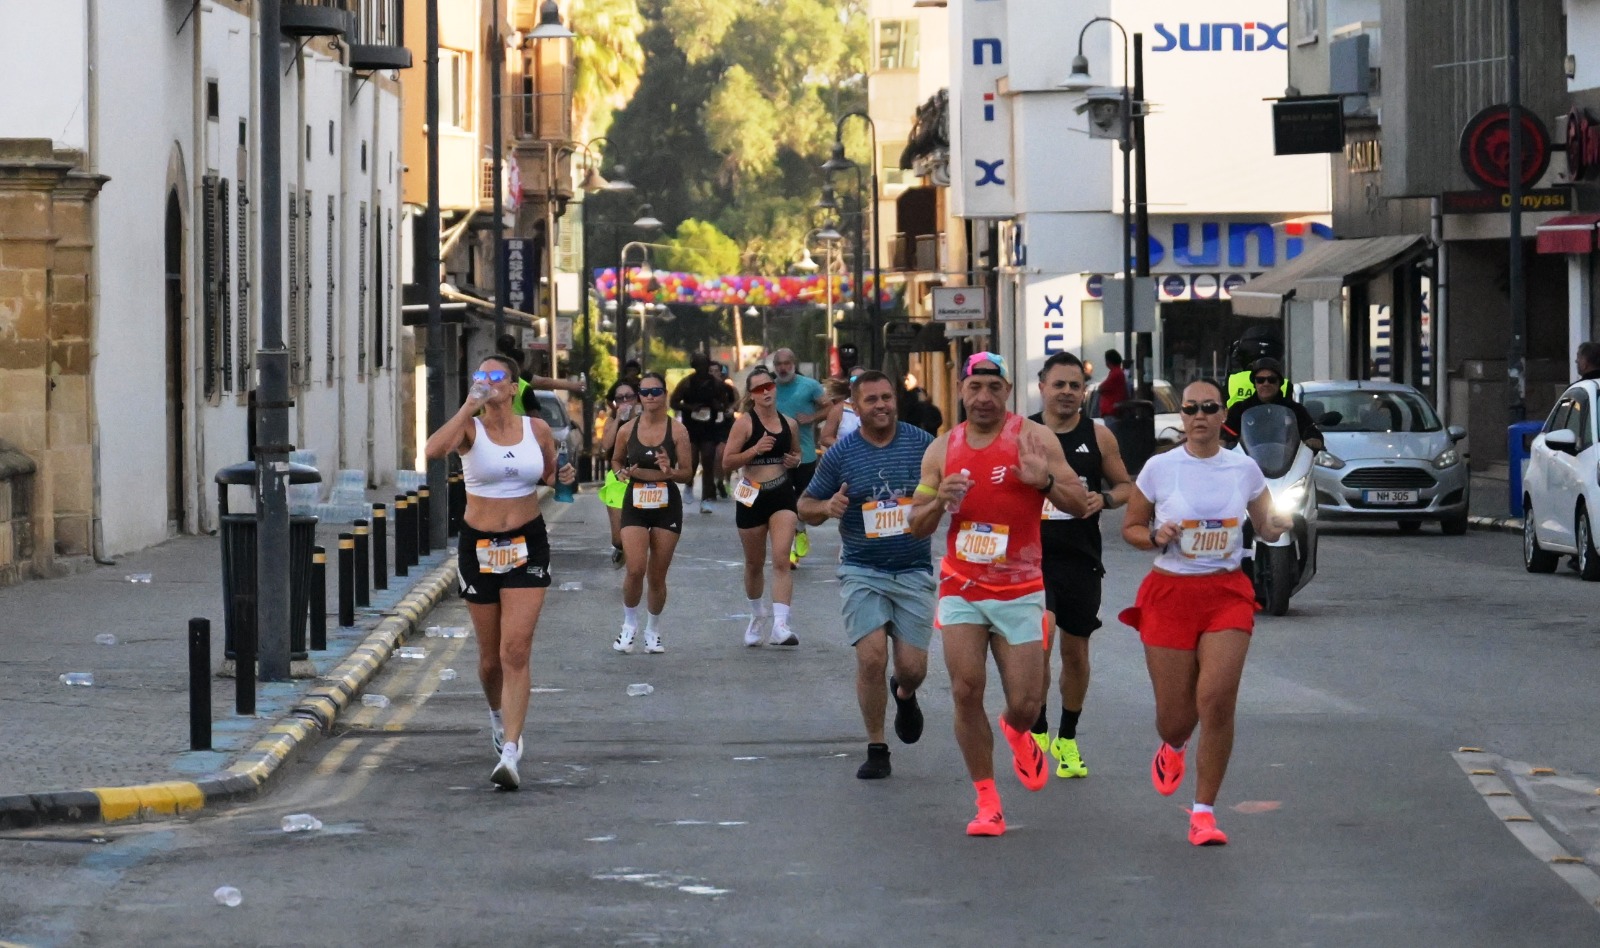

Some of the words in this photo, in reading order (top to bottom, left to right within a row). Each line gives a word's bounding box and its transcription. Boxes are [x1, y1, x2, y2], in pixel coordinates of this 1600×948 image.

[1152, 22, 1288, 51] sunix
[639, 490, 662, 503] 21032
[1377, 492, 1390, 501] NH
[1392, 492, 1409, 501] 305
[875, 508, 904, 530] 21114
[963, 533, 999, 556] 21095
[1191, 531, 1228, 551] 21019
[487, 547, 519, 566] 21015
